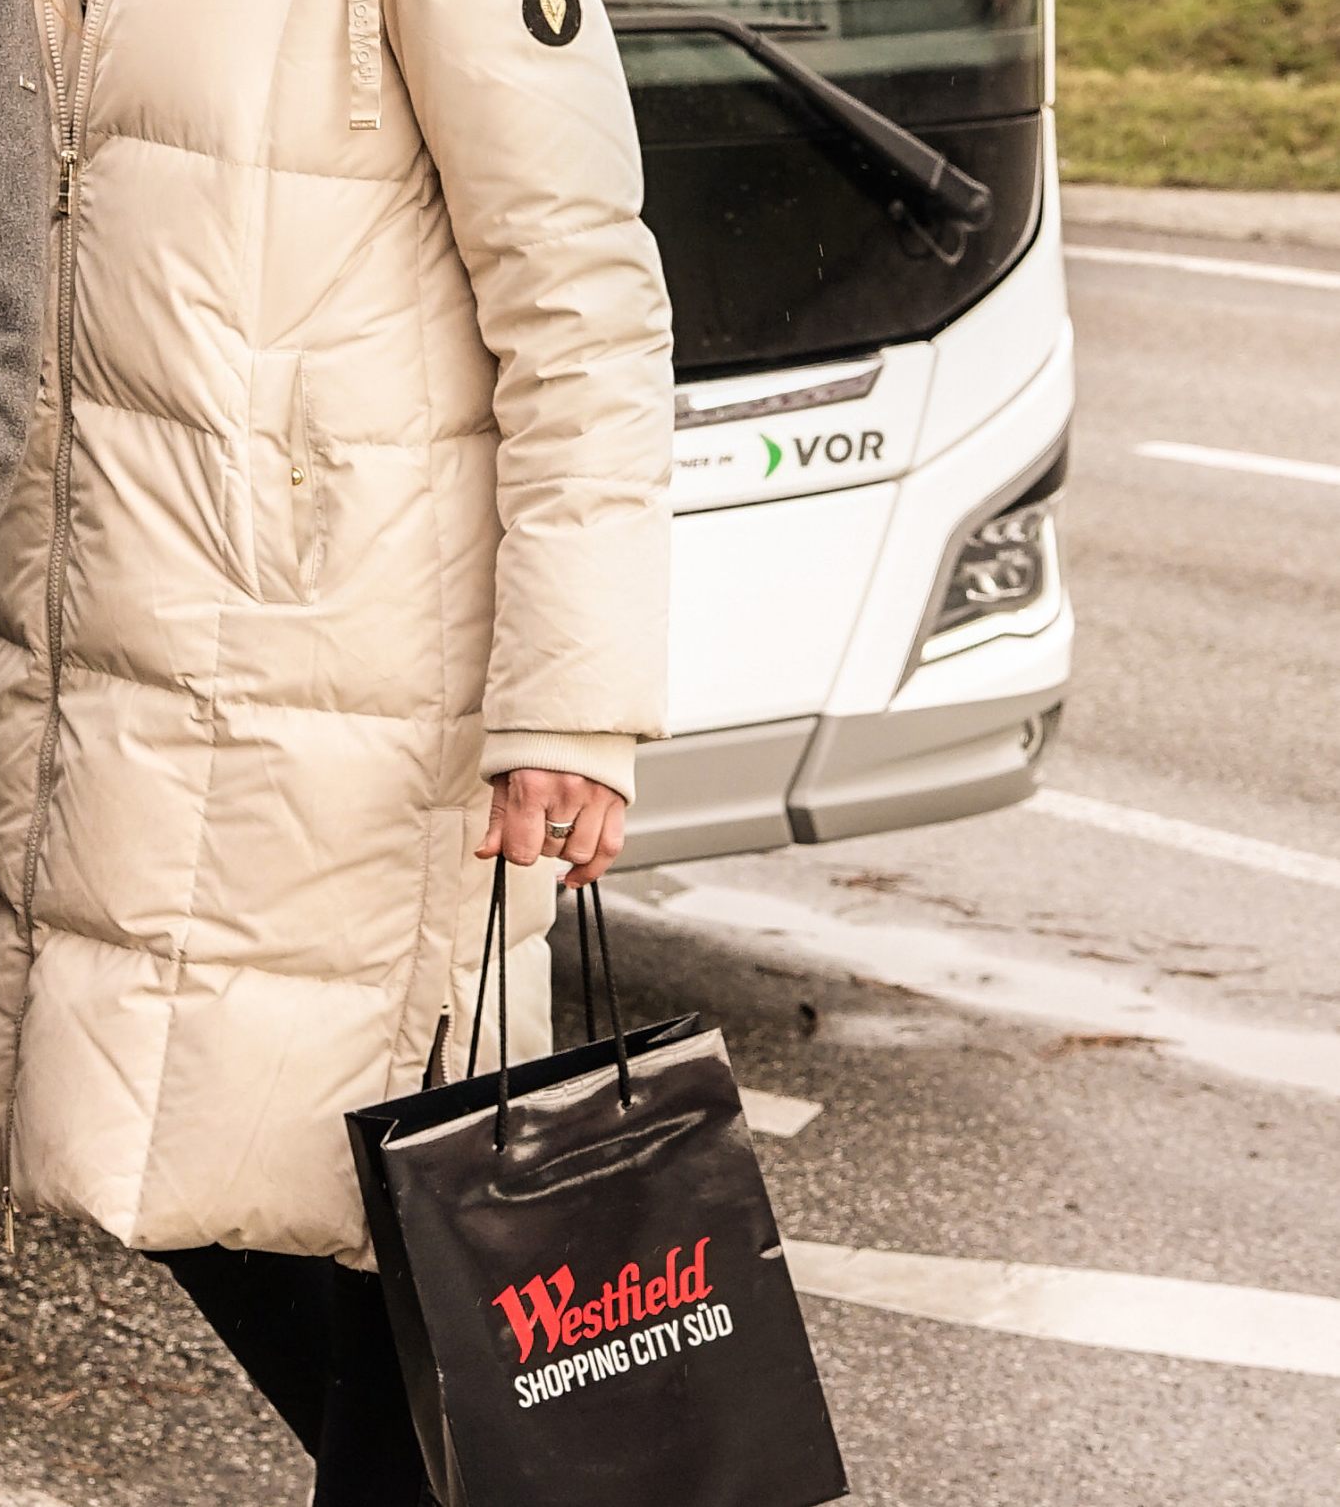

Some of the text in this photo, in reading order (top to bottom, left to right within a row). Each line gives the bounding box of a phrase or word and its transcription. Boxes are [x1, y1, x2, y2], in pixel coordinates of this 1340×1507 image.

[793, 430, 886, 467] VOR
[491, 1236, 714, 1365] Westfield
[513, 1302, 734, 1409] SHOPPING CITY SÜD
